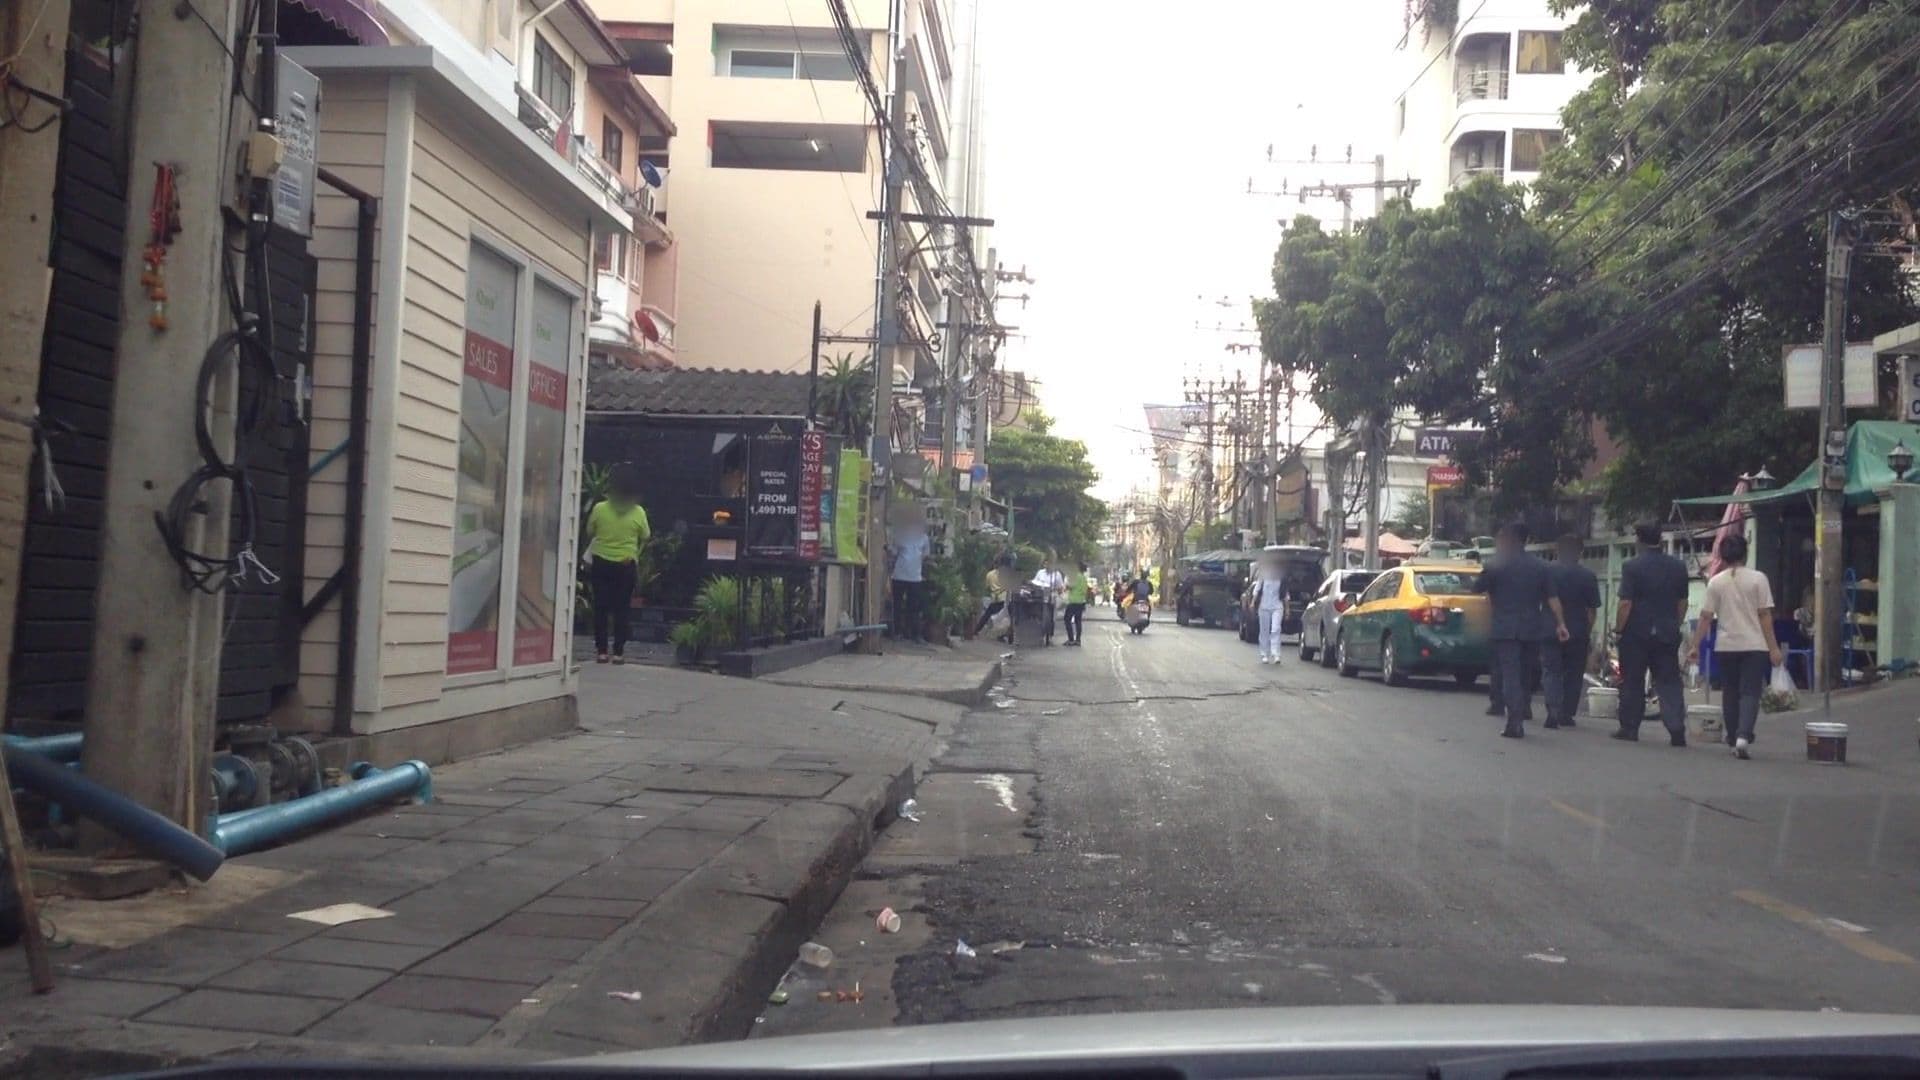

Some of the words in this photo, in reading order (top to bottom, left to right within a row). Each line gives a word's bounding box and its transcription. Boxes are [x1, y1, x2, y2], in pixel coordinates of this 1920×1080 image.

[468, 343, 498, 375] SALES
[530, 369, 558, 399] OFFICE
[758, 494, 786, 503] FROM
[750, 506, 775, 515] 1,499
[777, 506, 796, 514] THB
